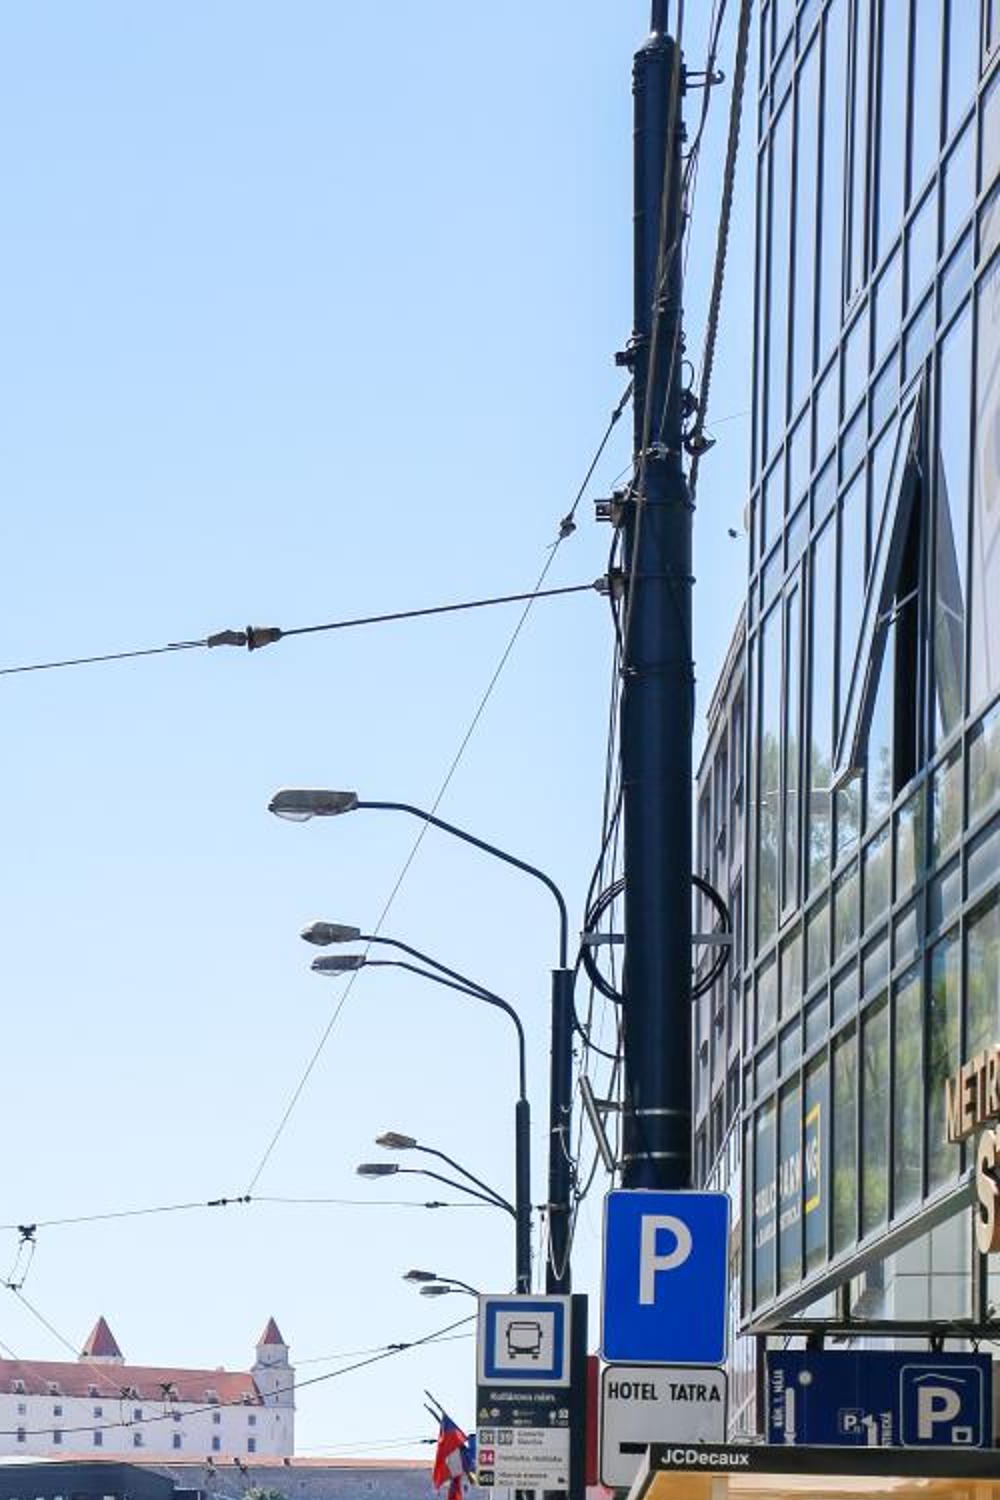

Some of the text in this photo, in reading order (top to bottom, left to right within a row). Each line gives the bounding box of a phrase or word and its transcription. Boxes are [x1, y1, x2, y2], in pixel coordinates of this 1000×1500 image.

[638, 1214, 692, 1305] P
[608, 1382, 721, 1402] HOTEL TATRA
[917, 1386, 961, 1439] P
[844, 1415, 857, 1431] P
[661, 1449, 750, 1465] JCDecaux
